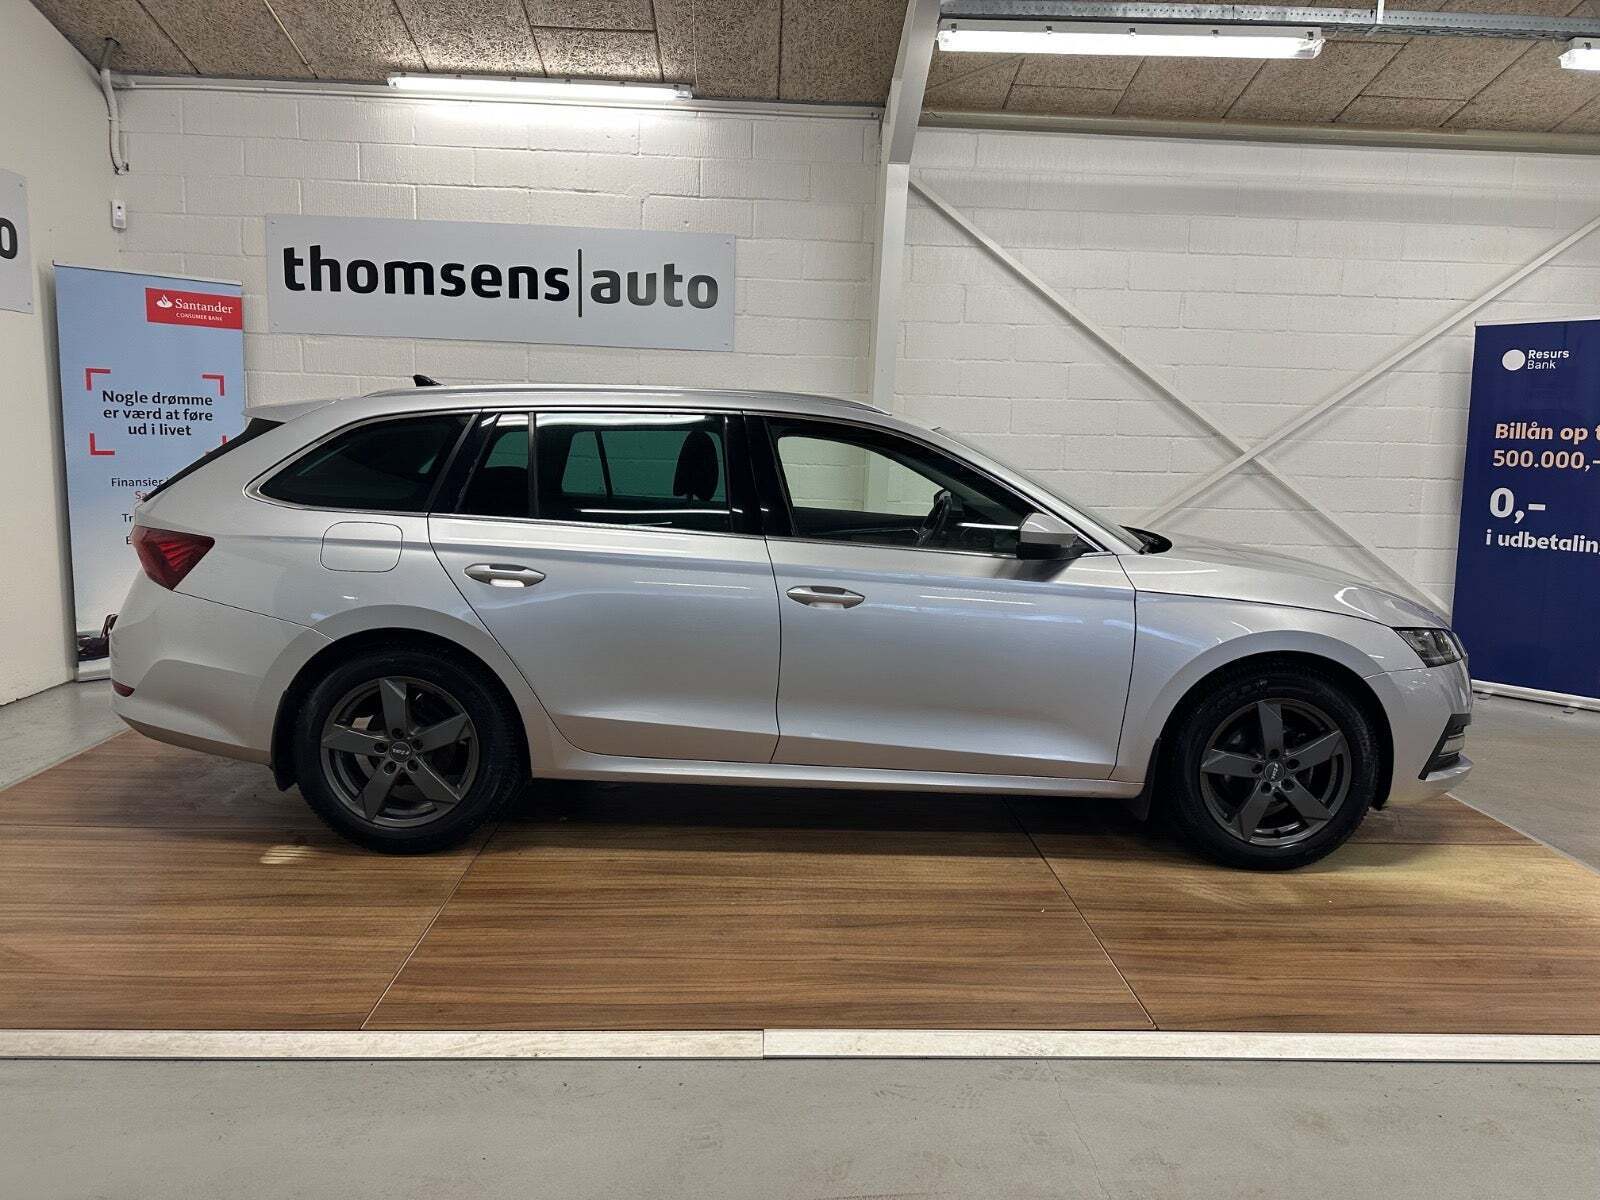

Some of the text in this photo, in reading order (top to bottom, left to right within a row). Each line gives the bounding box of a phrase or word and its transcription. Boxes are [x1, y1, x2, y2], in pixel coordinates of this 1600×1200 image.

[175, 298, 233, 314] Santander
[175, 312, 207, 320] CONSUMER
[1528, 349, 1570, 360] Resurs
[1527, 360, 1556, 370] Bank
[102, 390, 213, 406] Nogle drømme
[103, 408, 213, 421] er værd at føre
[128, 423, 192, 436] ud i livet
[1495, 421, 1554, 440] Billån
[1560, 427, 1588, 445] op
[111, 477, 168, 488] Finansier
[1489, 487, 1546, 524] 0,-
[1485, 528, 1600, 555] i udbetalin
